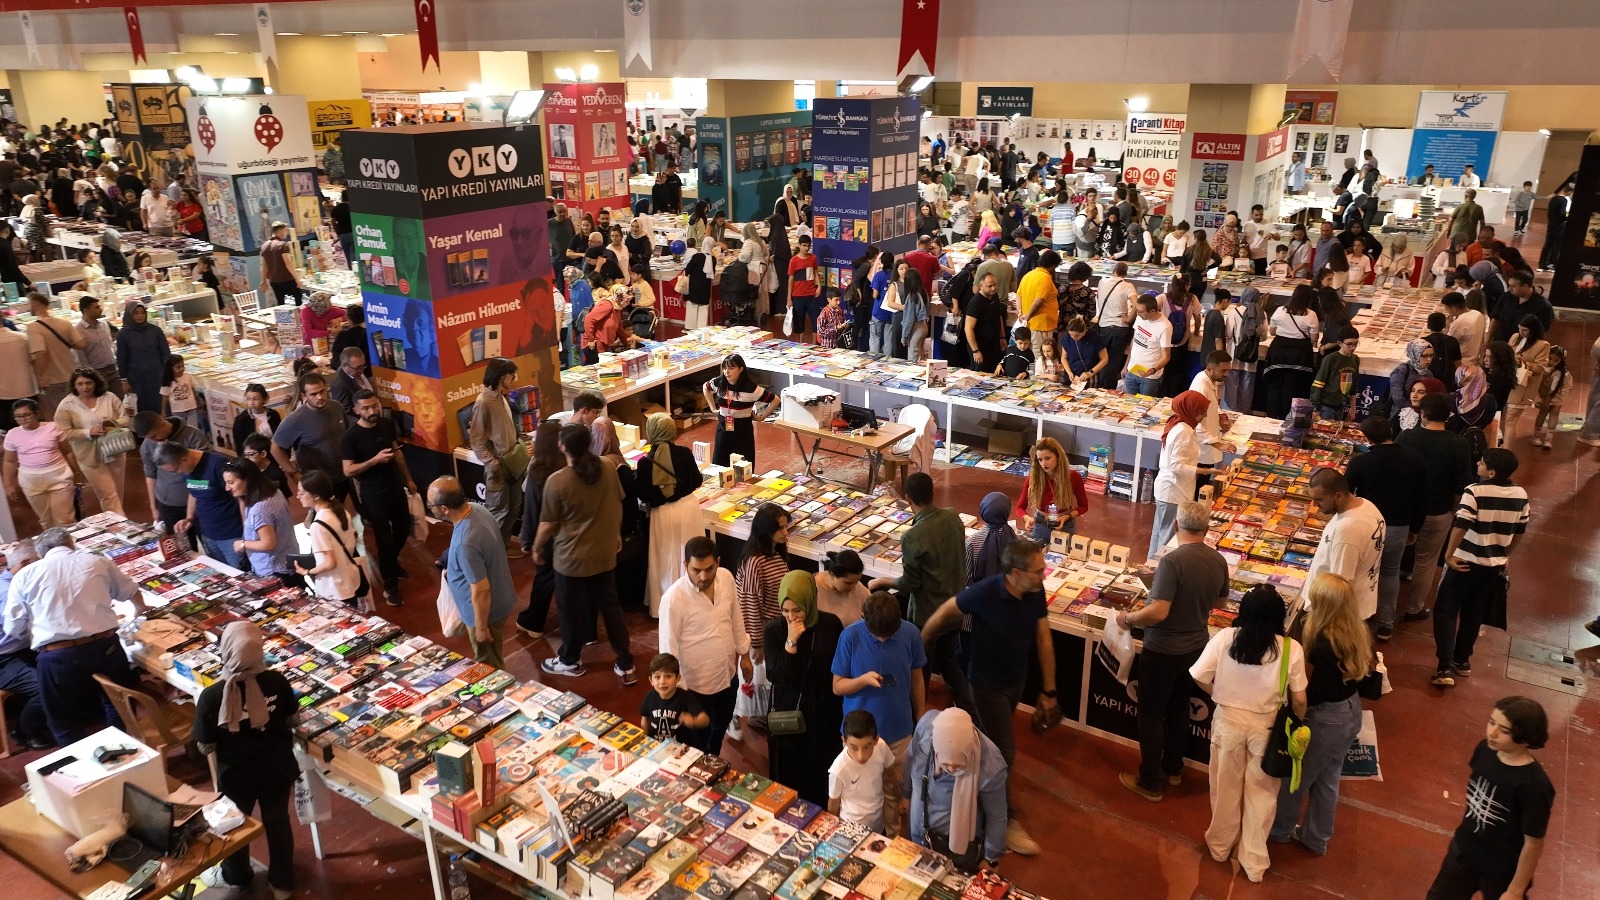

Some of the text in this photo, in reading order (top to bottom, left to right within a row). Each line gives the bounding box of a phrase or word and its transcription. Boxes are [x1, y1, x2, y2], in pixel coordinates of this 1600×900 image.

[1131, 118, 1185, 134] Garanti Kitap
[237, 157, 278, 169] uğurböceği
[1127, 170, 1138, 178] 30
[1145, 171, 1157, 179] 40
[347, 179, 418, 194] YAPI KREDİ YAYINLARI
[421, 174, 544, 201] YAPI KREDİ YAYINLARI
[355, 225, 382, 237] Orhan
[428, 224, 503, 250] Yaşar Kemal
[357, 237, 387, 250] Pamuk
[366, 302, 388, 315] Amin
[438, 298, 521, 329] Nâzım Hikmet
[367, 314, 402, 329] Maalouf
[447, 382, 486, 402] Sabaha
[652, 709, 676, 719] WE ARE
[1348, 746, 1371, 755] onik
